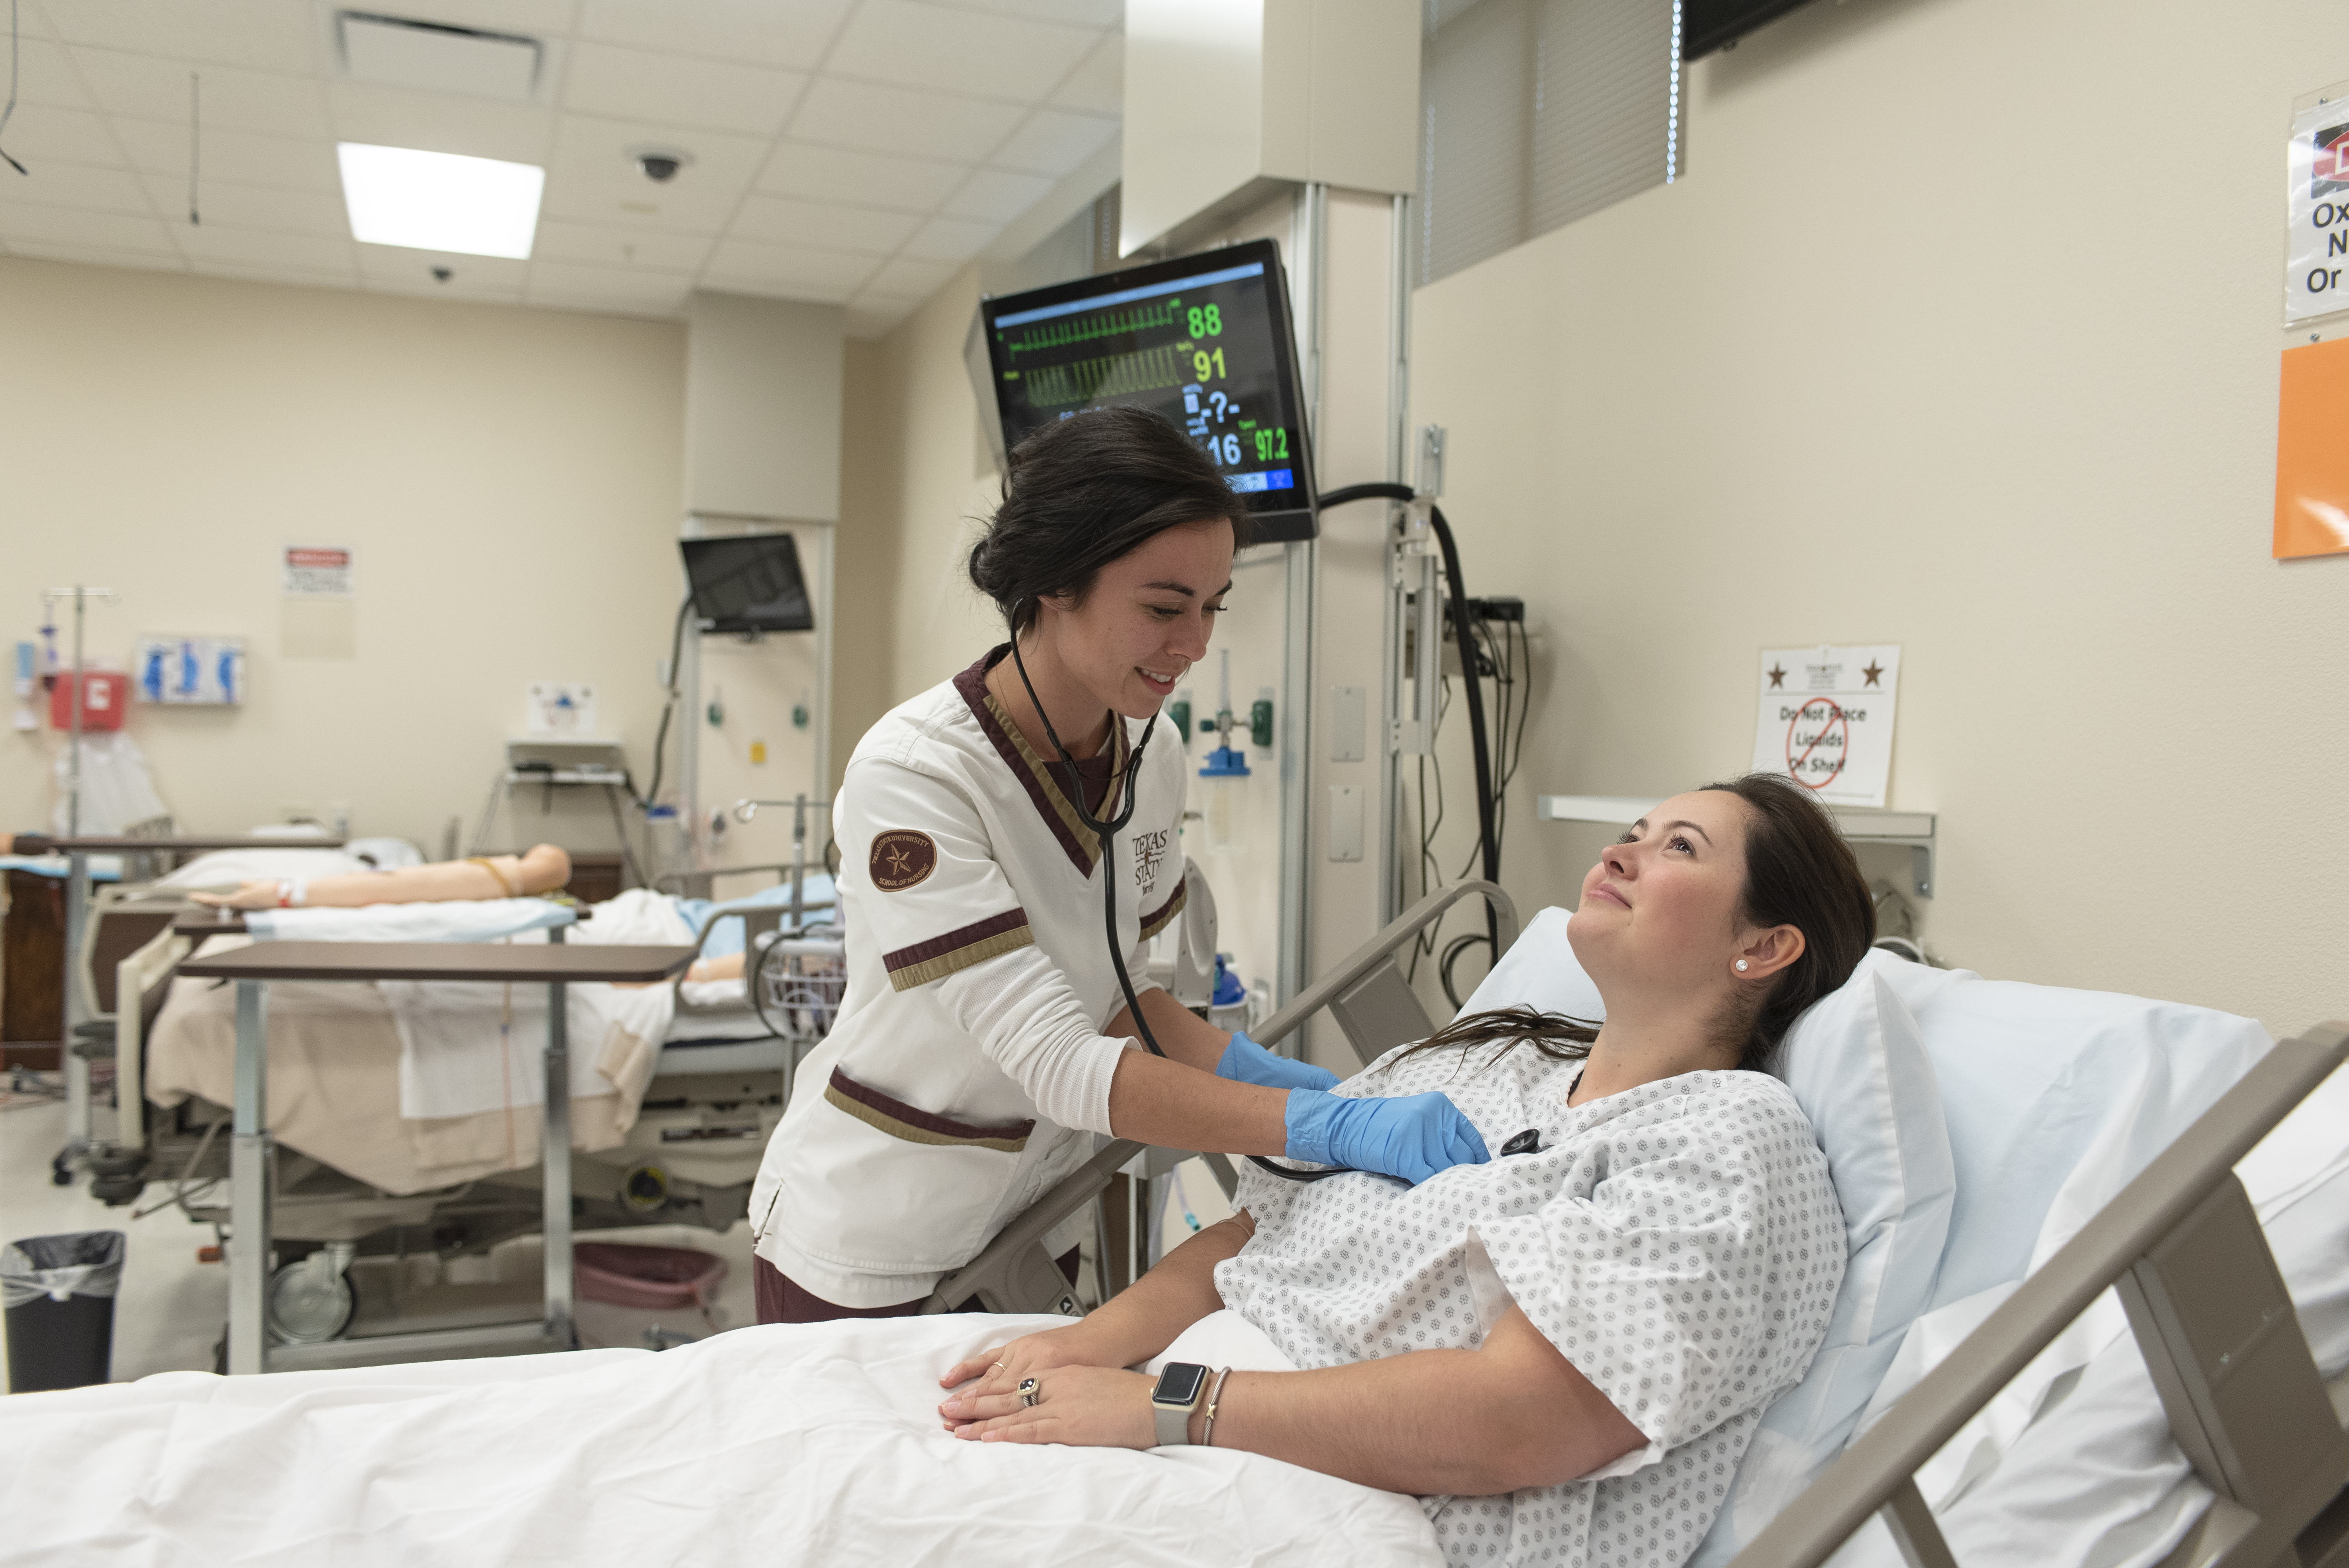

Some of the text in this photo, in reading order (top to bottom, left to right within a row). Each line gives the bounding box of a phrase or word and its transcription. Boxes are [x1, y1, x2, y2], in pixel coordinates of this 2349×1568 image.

[2313, 203, 2349, 228] Ox
[2307, 268, 2342, 293] Or
[1187, 303, 1223, 339] 88
[1193, 347, 1226, 382] 91
[1207, 433, 1242, 466] 16
[1255, 427, 1289, 462] 97.2
[1779, 706, 1867, 722] Do Not Place
[1797, 731, 1842, 747] Liquids
[1811, 756, 1846, 773] Shelf
[872, 835, 929, 864] TEXAS STATE UNIVERSITY
[1132, 829, 1167, 856] TEXAS
[879, 877, 898, 886] SCHOOL
[907, 863, 929, 884] NURSING
